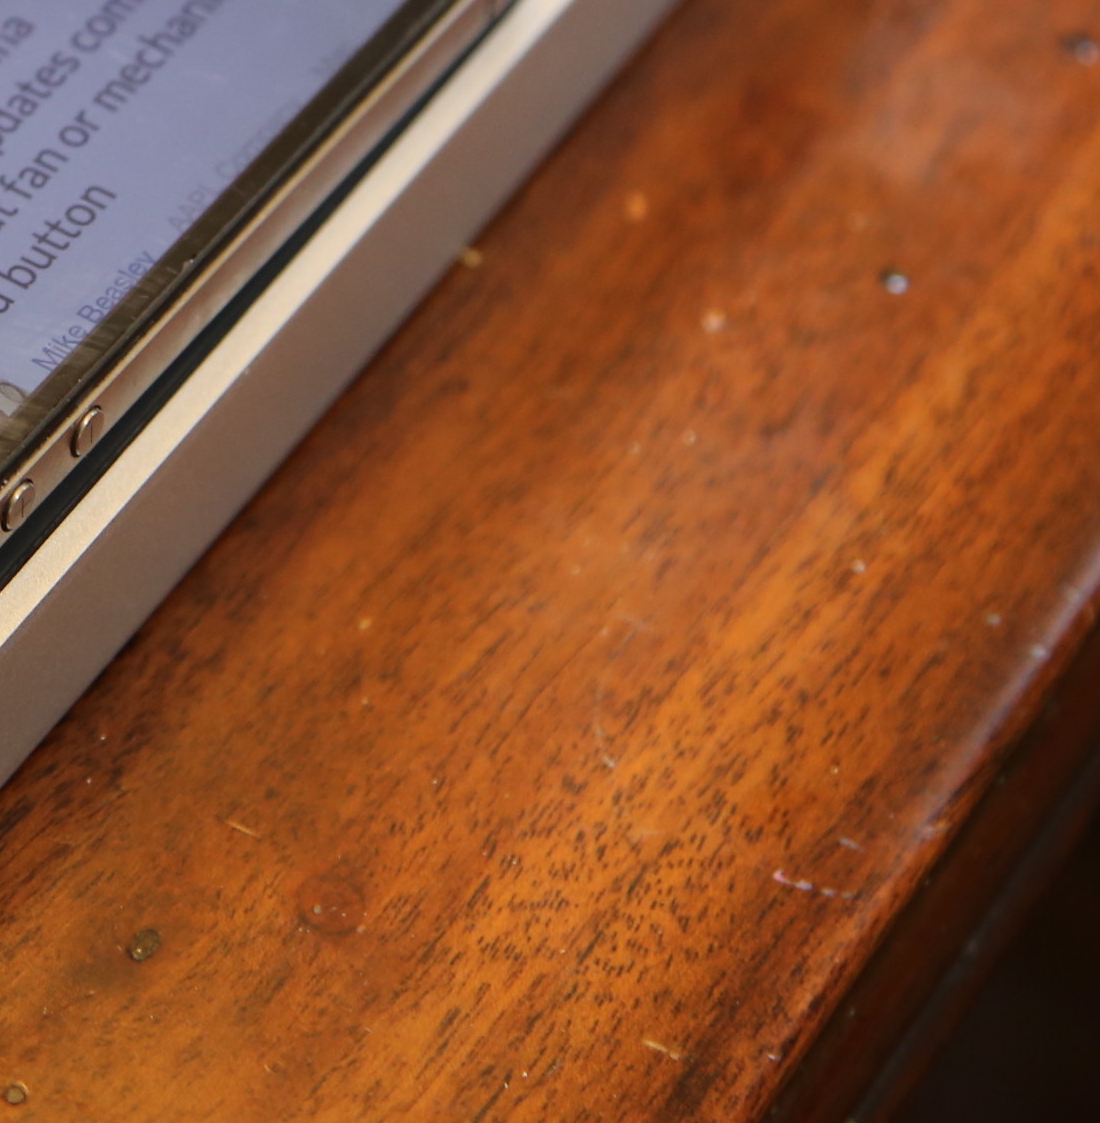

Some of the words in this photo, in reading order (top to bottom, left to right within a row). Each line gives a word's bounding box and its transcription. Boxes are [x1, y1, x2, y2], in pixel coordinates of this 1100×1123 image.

[58, 109, 101, 149] or
[31, 325, 88, 372] Mike
[76, 250, 157, 323] Beasley
